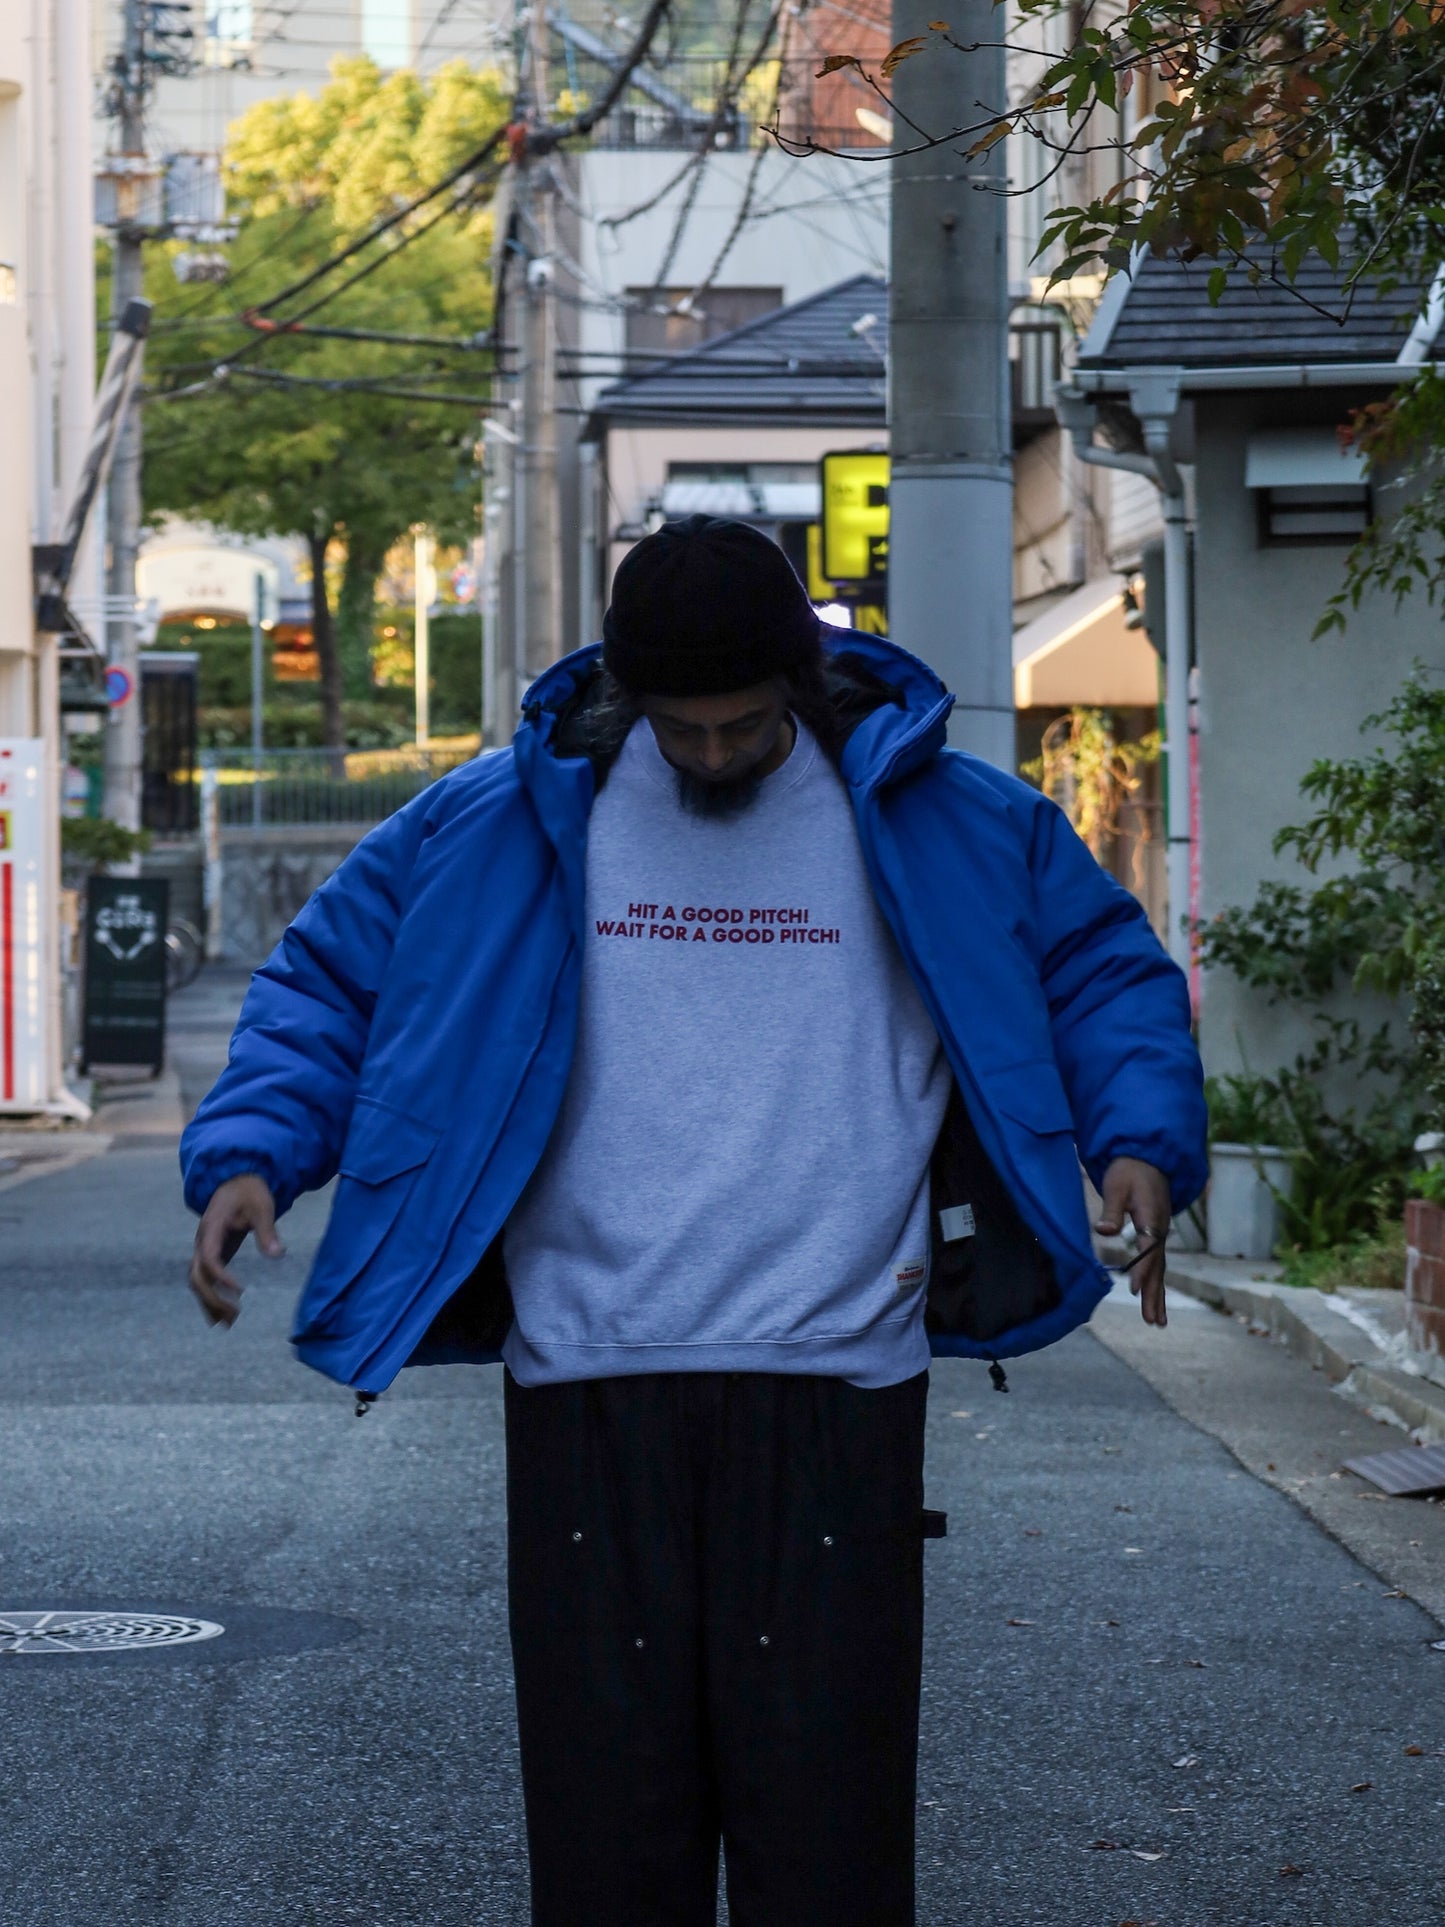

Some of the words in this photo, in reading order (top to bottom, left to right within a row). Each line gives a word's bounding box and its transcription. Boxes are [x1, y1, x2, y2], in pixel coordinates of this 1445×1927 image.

[628, 903, 659, 920] HIT
[662, 905, 676, 921] A
[681, 907, 744, 924] GOOD
[749, 908, 809, 924] PITCH!
[596, 921, 645, 938] WAIT
[649, 924, 688, 941] FOR
[692, 927, 707, 942] A
[711, 928, 775, 944] GOOD
[779, 929, 840, 944] PITCH!
